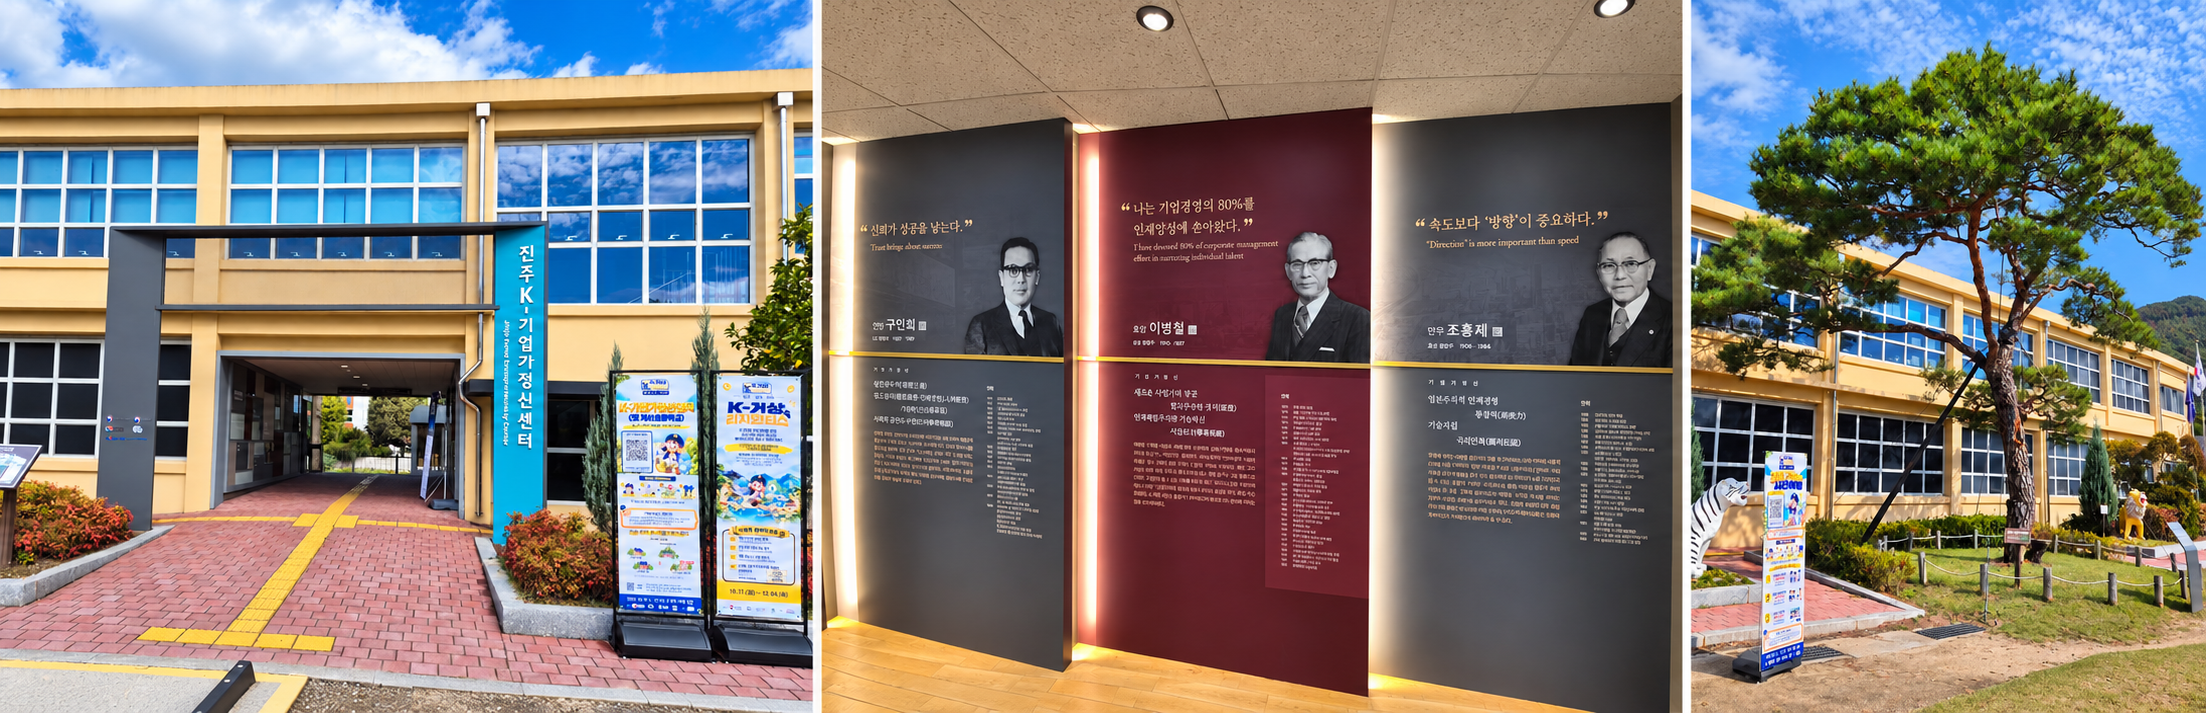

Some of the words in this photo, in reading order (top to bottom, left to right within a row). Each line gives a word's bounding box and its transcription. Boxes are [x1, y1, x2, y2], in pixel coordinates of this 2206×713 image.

[1159, 198, 1214, 214] 기업경영의
[900, 222, 928, 236] 성공을
[1134, 221, 1188, 236] 인재양성에
[1236, 241, 1278, 250] management
[1498, 238, 1536, 248] important
[1558, 236, 1579, 246] speed
[1150, 322, 1184, 336] 이병철
[1446, 322, 1488, 338] 조홍제
